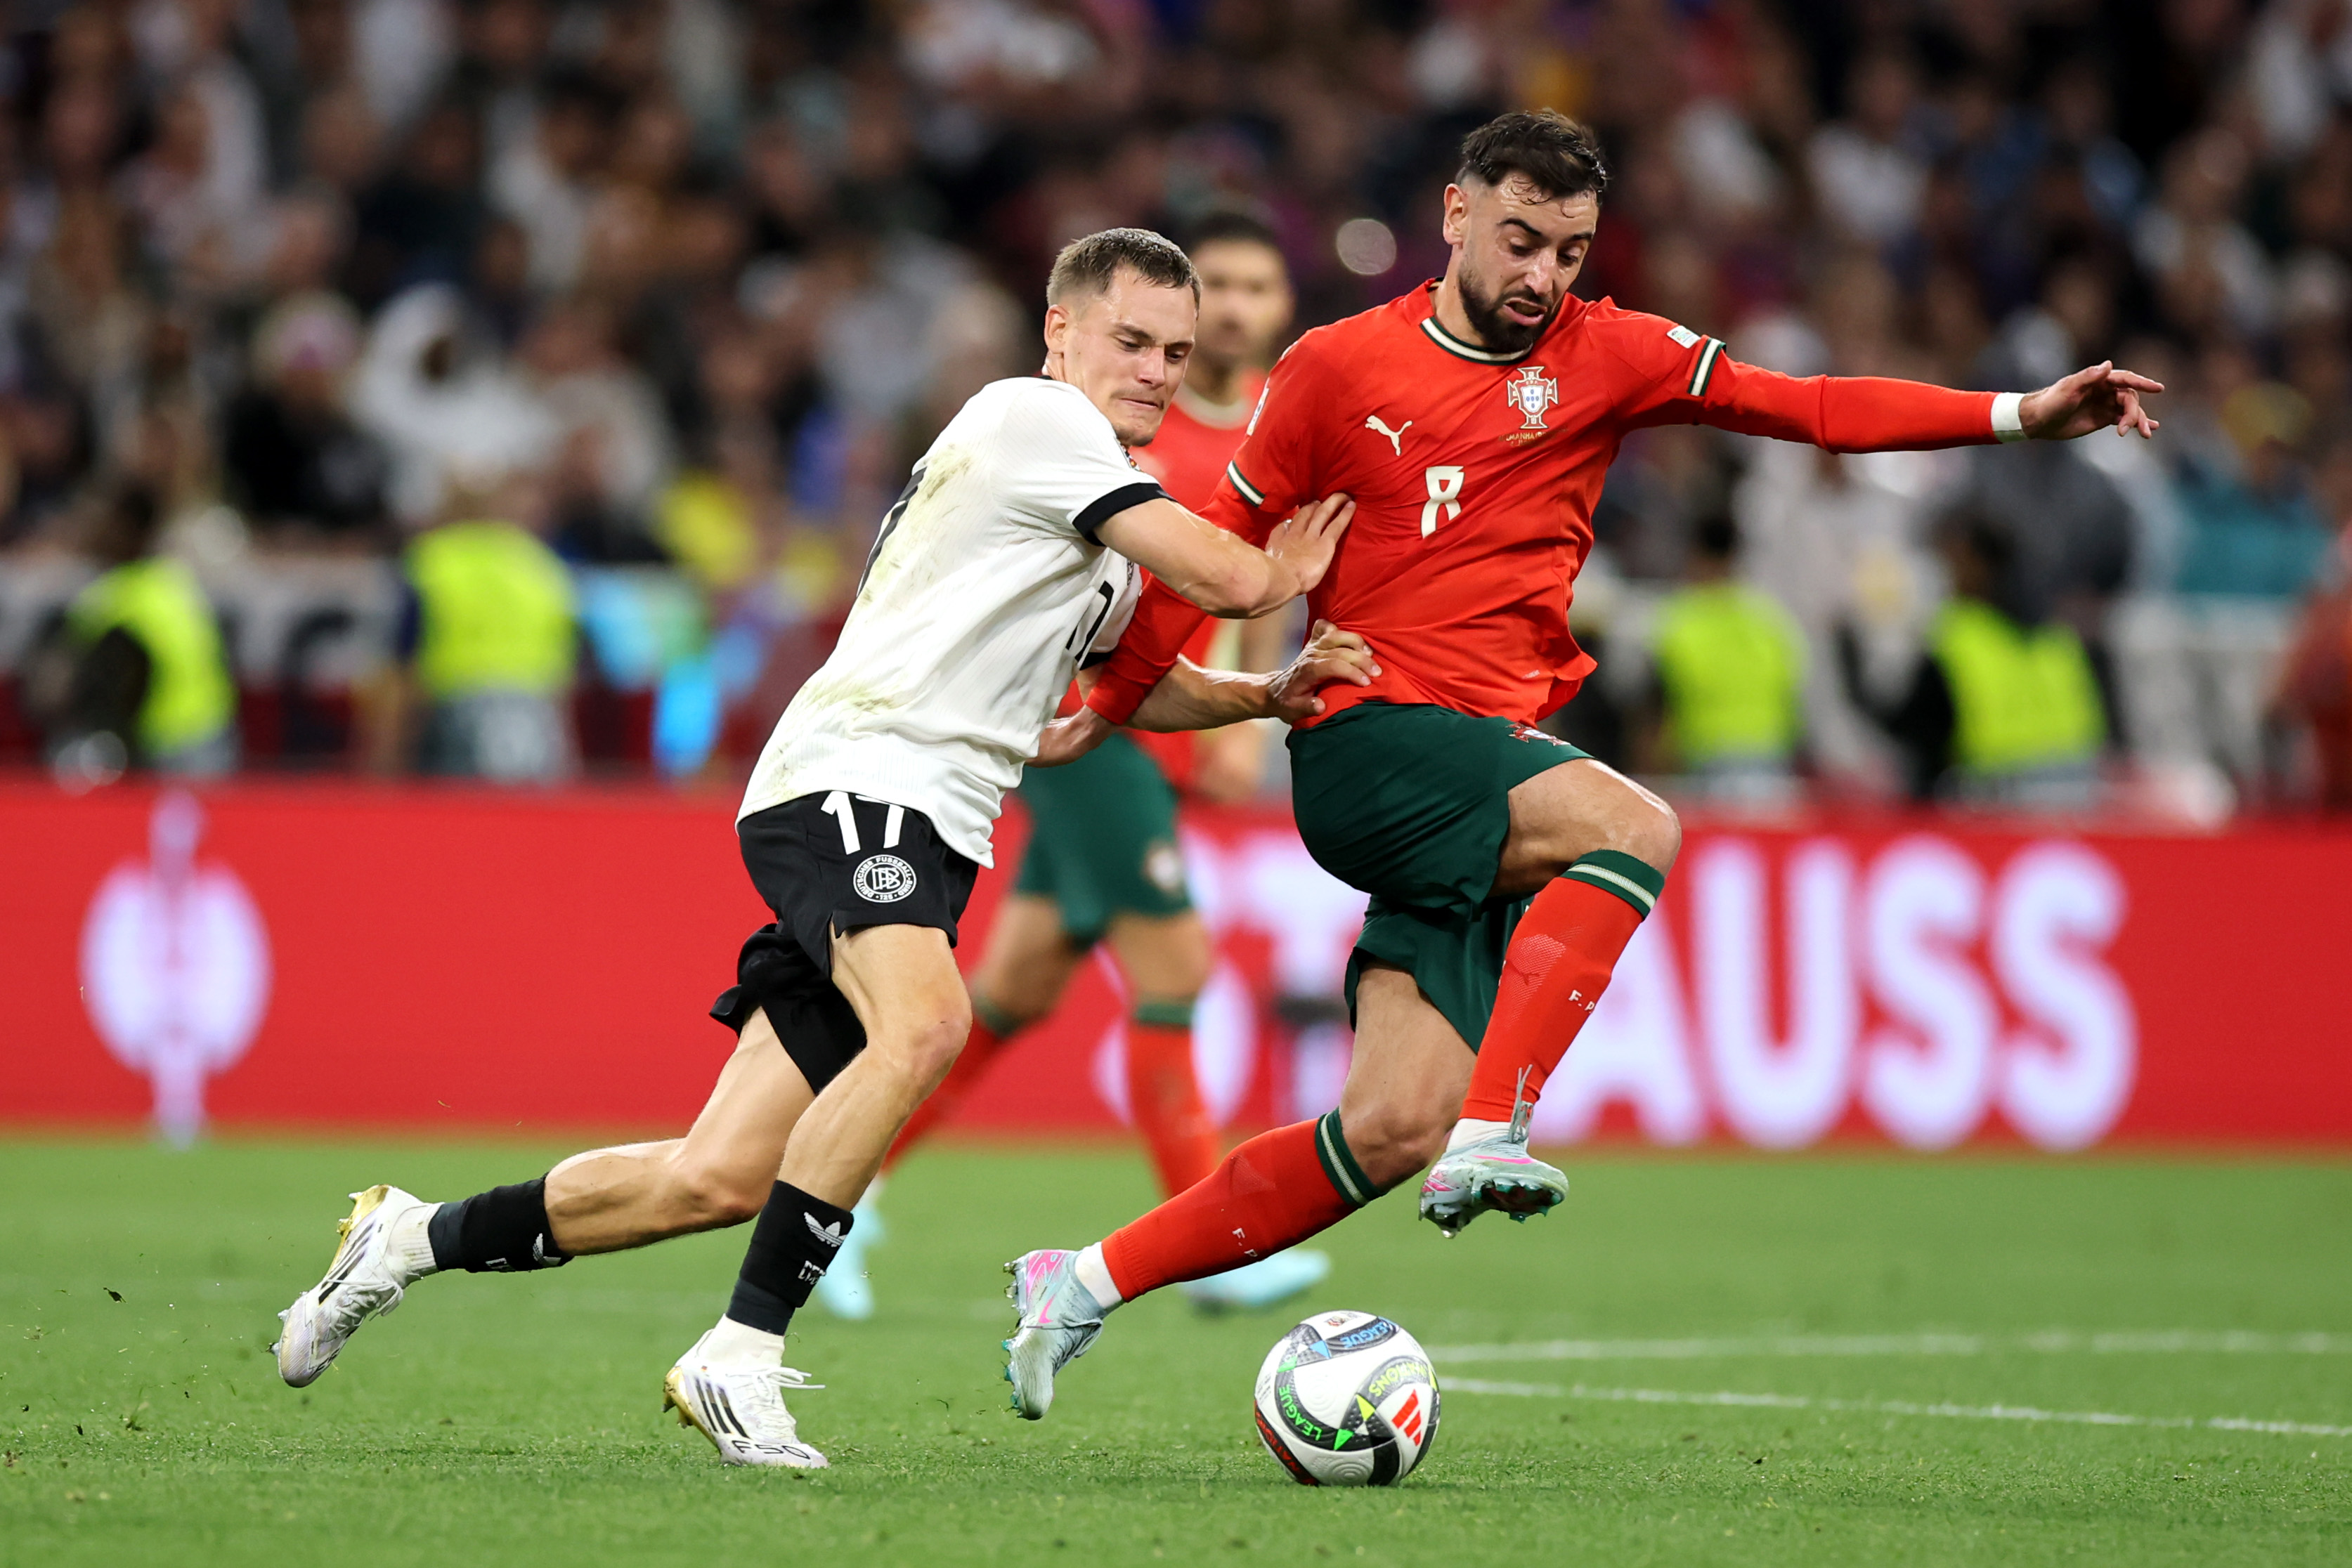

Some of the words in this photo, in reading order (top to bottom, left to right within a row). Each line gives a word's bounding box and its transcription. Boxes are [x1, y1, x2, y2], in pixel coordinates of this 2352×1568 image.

[1420, 465, 1465, 540] 8
[820, 790, 905, 856] 17
[1279, 1383, 1323, 1441] LEAGUE
[731, 1440, 811, 1460] F50
